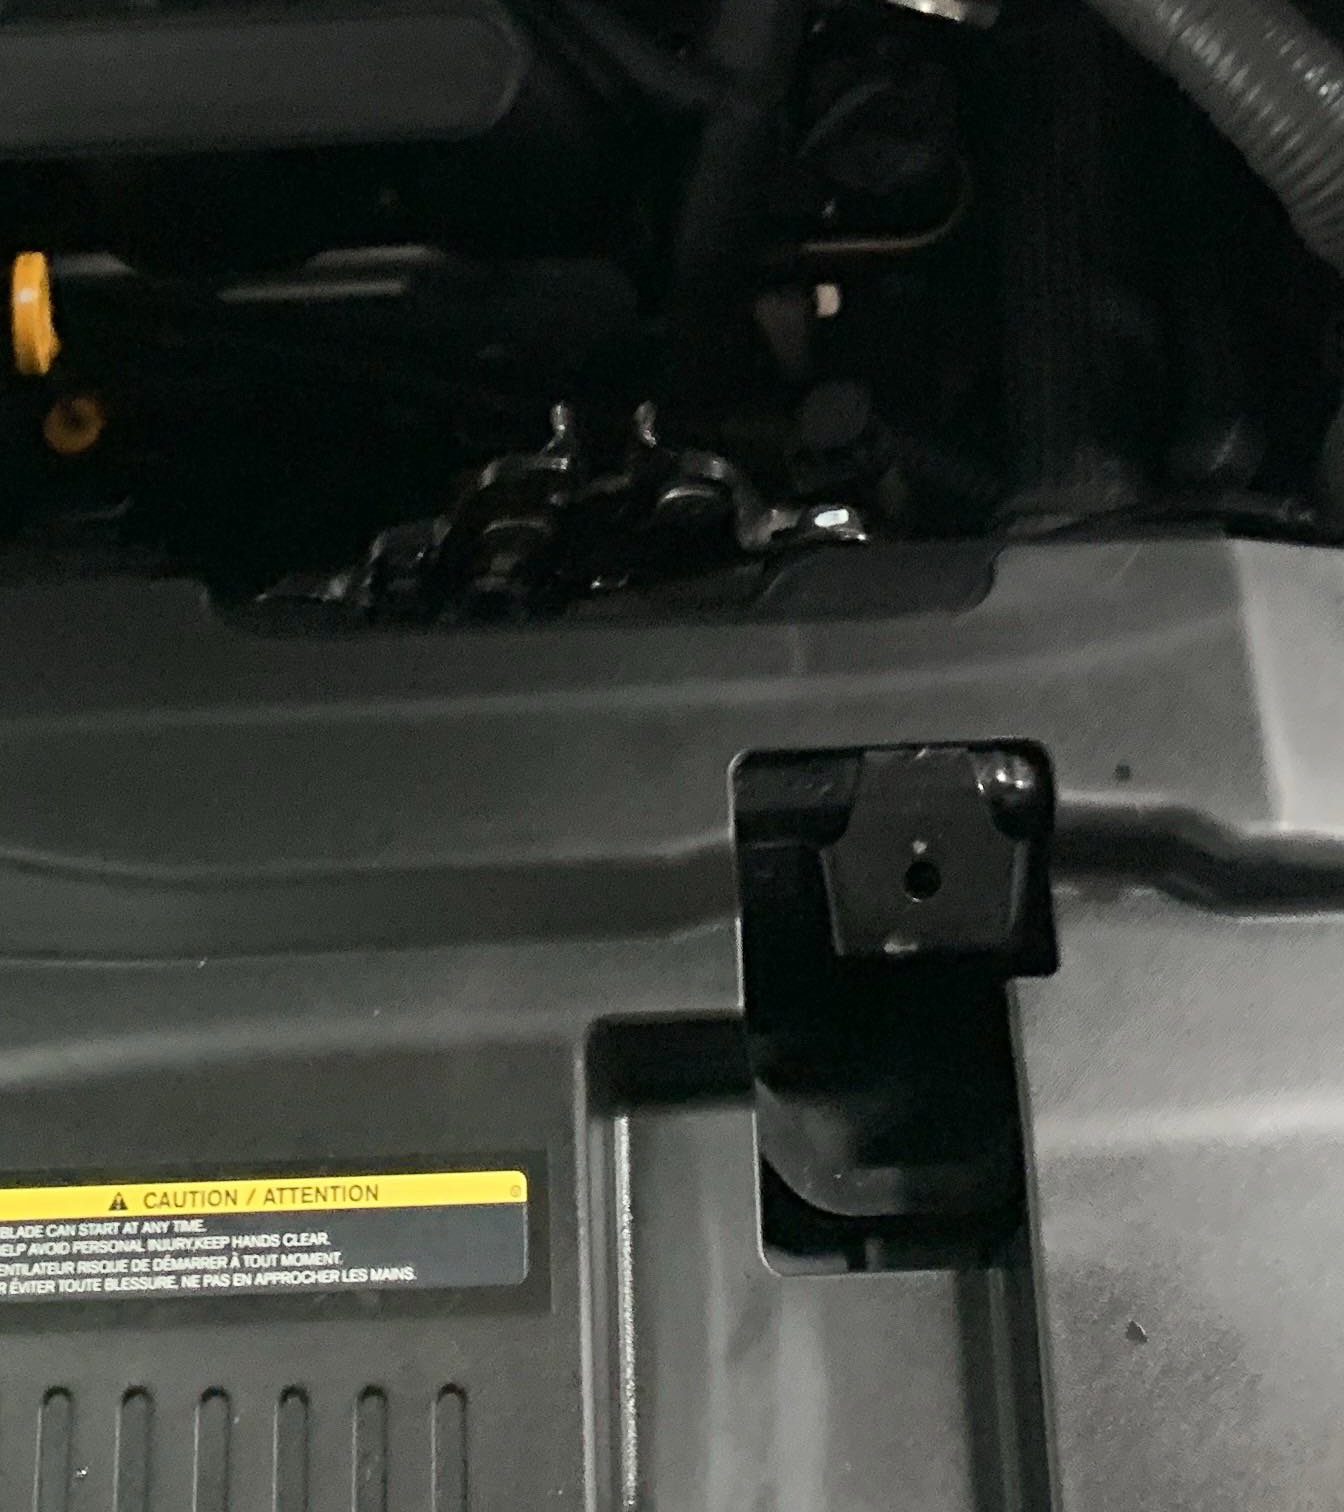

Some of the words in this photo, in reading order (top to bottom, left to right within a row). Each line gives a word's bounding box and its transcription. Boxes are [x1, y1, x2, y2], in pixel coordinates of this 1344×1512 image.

[143, 1188, 237, 1208] CAUTION
[247, 1188, 257, 1206] /
[263, 1184, 379, 1204] ATTENTION
[0, 1225, 44, 1238] BLADE
[46, 1224, 76, 1237] CAN
[78, 1222, 121, 1236] START
[122, 1222, 139, 1234] AT
[141, 1221, 170, 1234] ANY
[173, 1219, 207, 1233] TIME.
[27, 1242, 70, 1256] AVOID
[72, 1240, 145, 1254] PERSONAL
[232, 1235, 280, 1248] HANDS
[282, 1232, 331, 1246] CLEAR.
[76, 1259, 129, 1275] RISQUE
[131, 1258, 151, 1272] DE
[152, 1254, 228, 1271] DÉMARRER
[230, 1252, 240, 1268] À
[243, 1253, 278, 1267] TOUT
[281, 1251, 343, 1266] MOMENT.
[9, 1278, 55, 1295] ÉVITER
[58, 1278, 102, 1293] TOUTE
[181, 1274, 201, 1288] NE
[203, 1273, 230, 1287] PAS
[233, 1272, 251, 1286] EN
[254, 1269, 339, 1285] APPROCHER
[341, 1268, 368, 1281] LES
[370, 1266, 416, 1281] MAINS.
